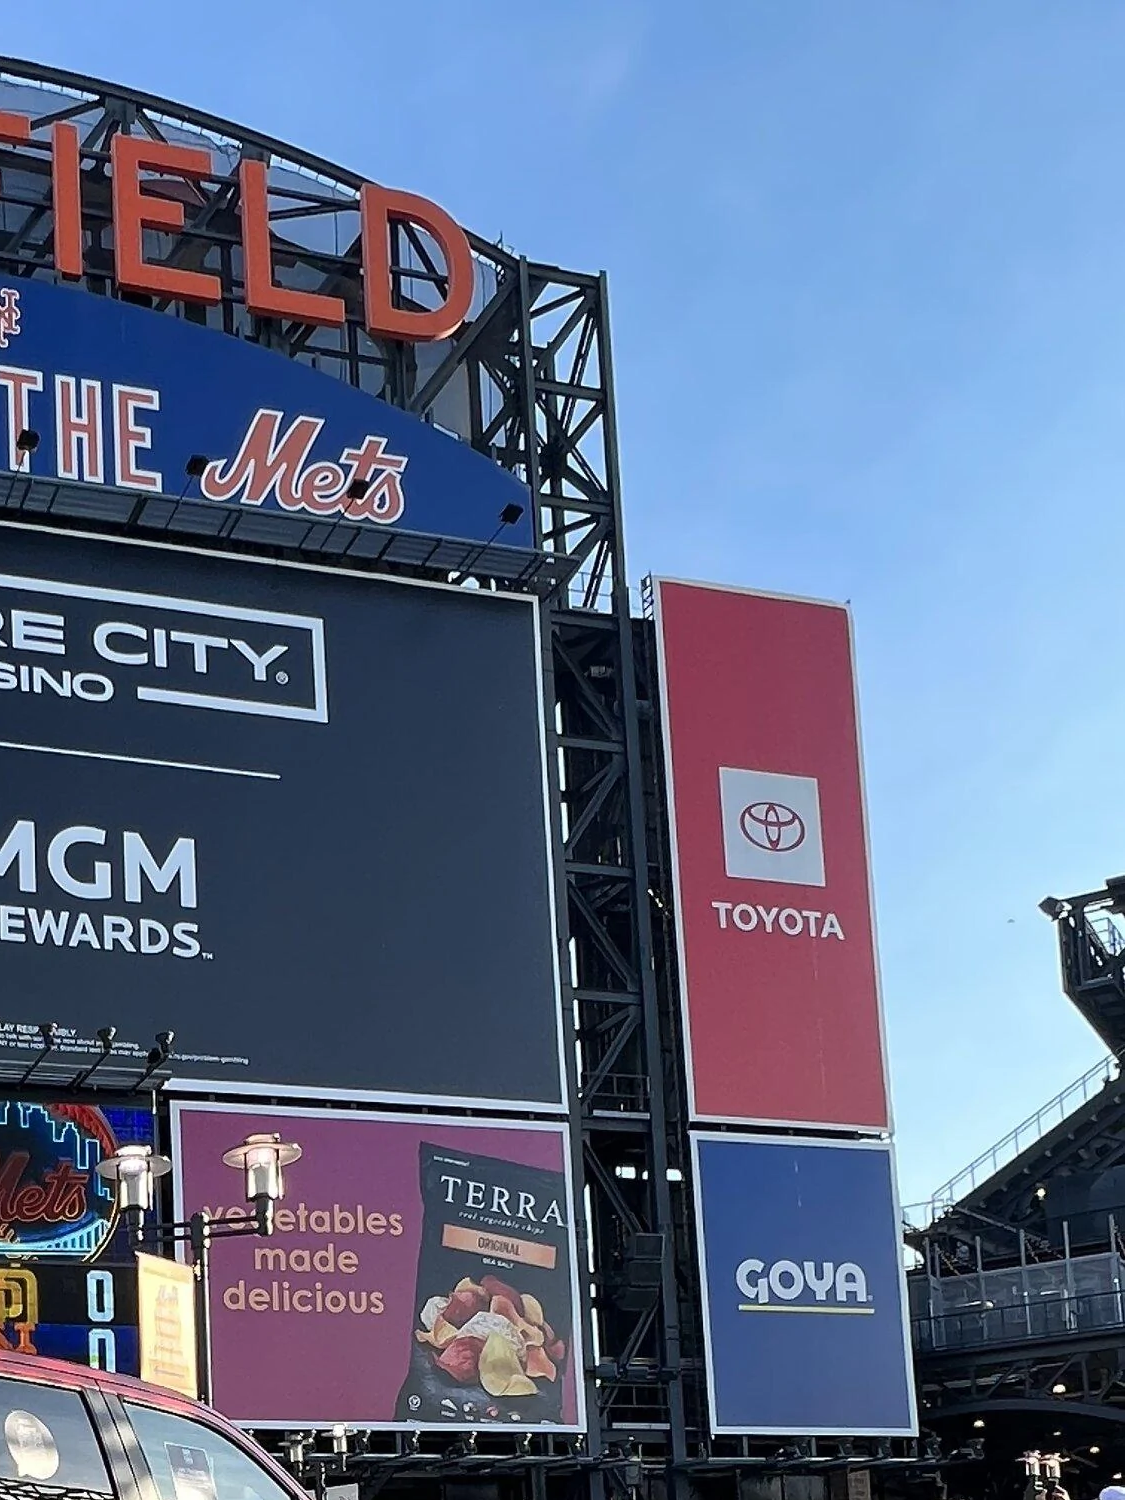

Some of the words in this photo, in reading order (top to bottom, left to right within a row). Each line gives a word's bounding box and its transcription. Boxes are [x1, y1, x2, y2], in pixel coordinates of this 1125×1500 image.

[199, 408, 408, 525] Mets
[92, 620, 288, 684] CITY
[711, 900, 847, 941] TOYOTA
[203, 1202, 404, 1237] veetables
[440, 1174, 566, 1228] TERRA
[254, 1243, 359, 1274] made
[477, 1236, 522, 1256] ORIGINAL
[86, 1269, 115, 1322] 0
[223, 1280, 385, 1315] delicious
[735, 1257, 869, 1305] GOYA
